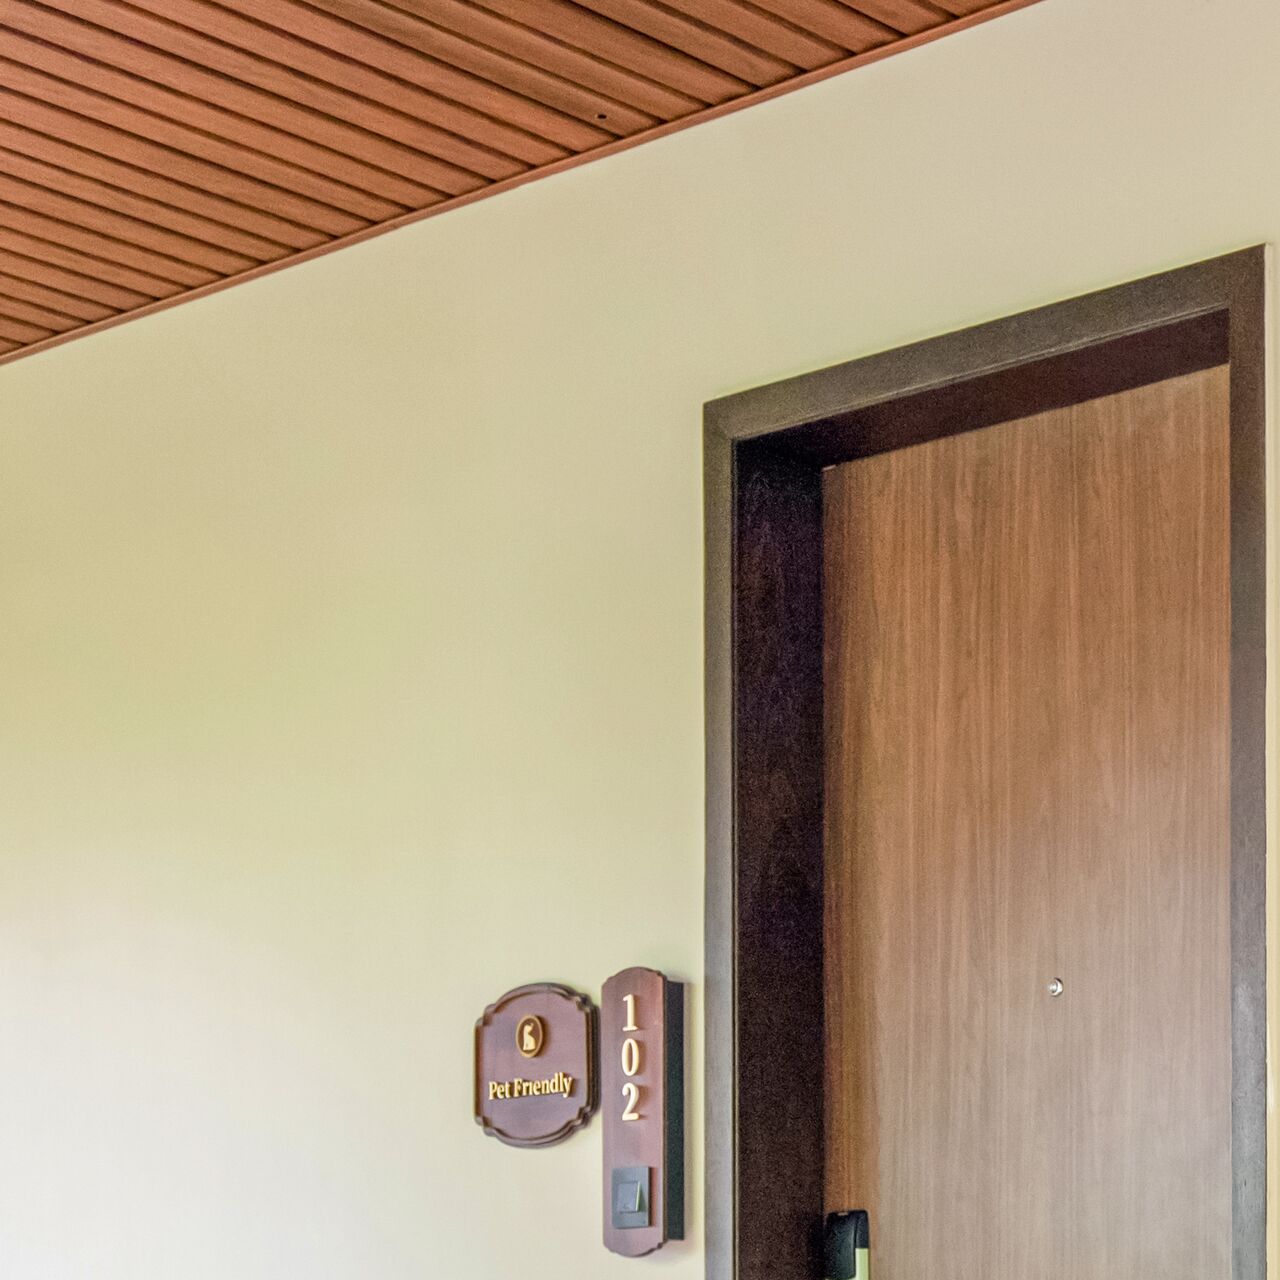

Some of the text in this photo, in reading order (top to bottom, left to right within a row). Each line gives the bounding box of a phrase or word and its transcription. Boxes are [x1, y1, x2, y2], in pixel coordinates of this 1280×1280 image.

[488, 1071, 573, 1100] Pet Friendly
[621, 993, 640, 1121] 102
